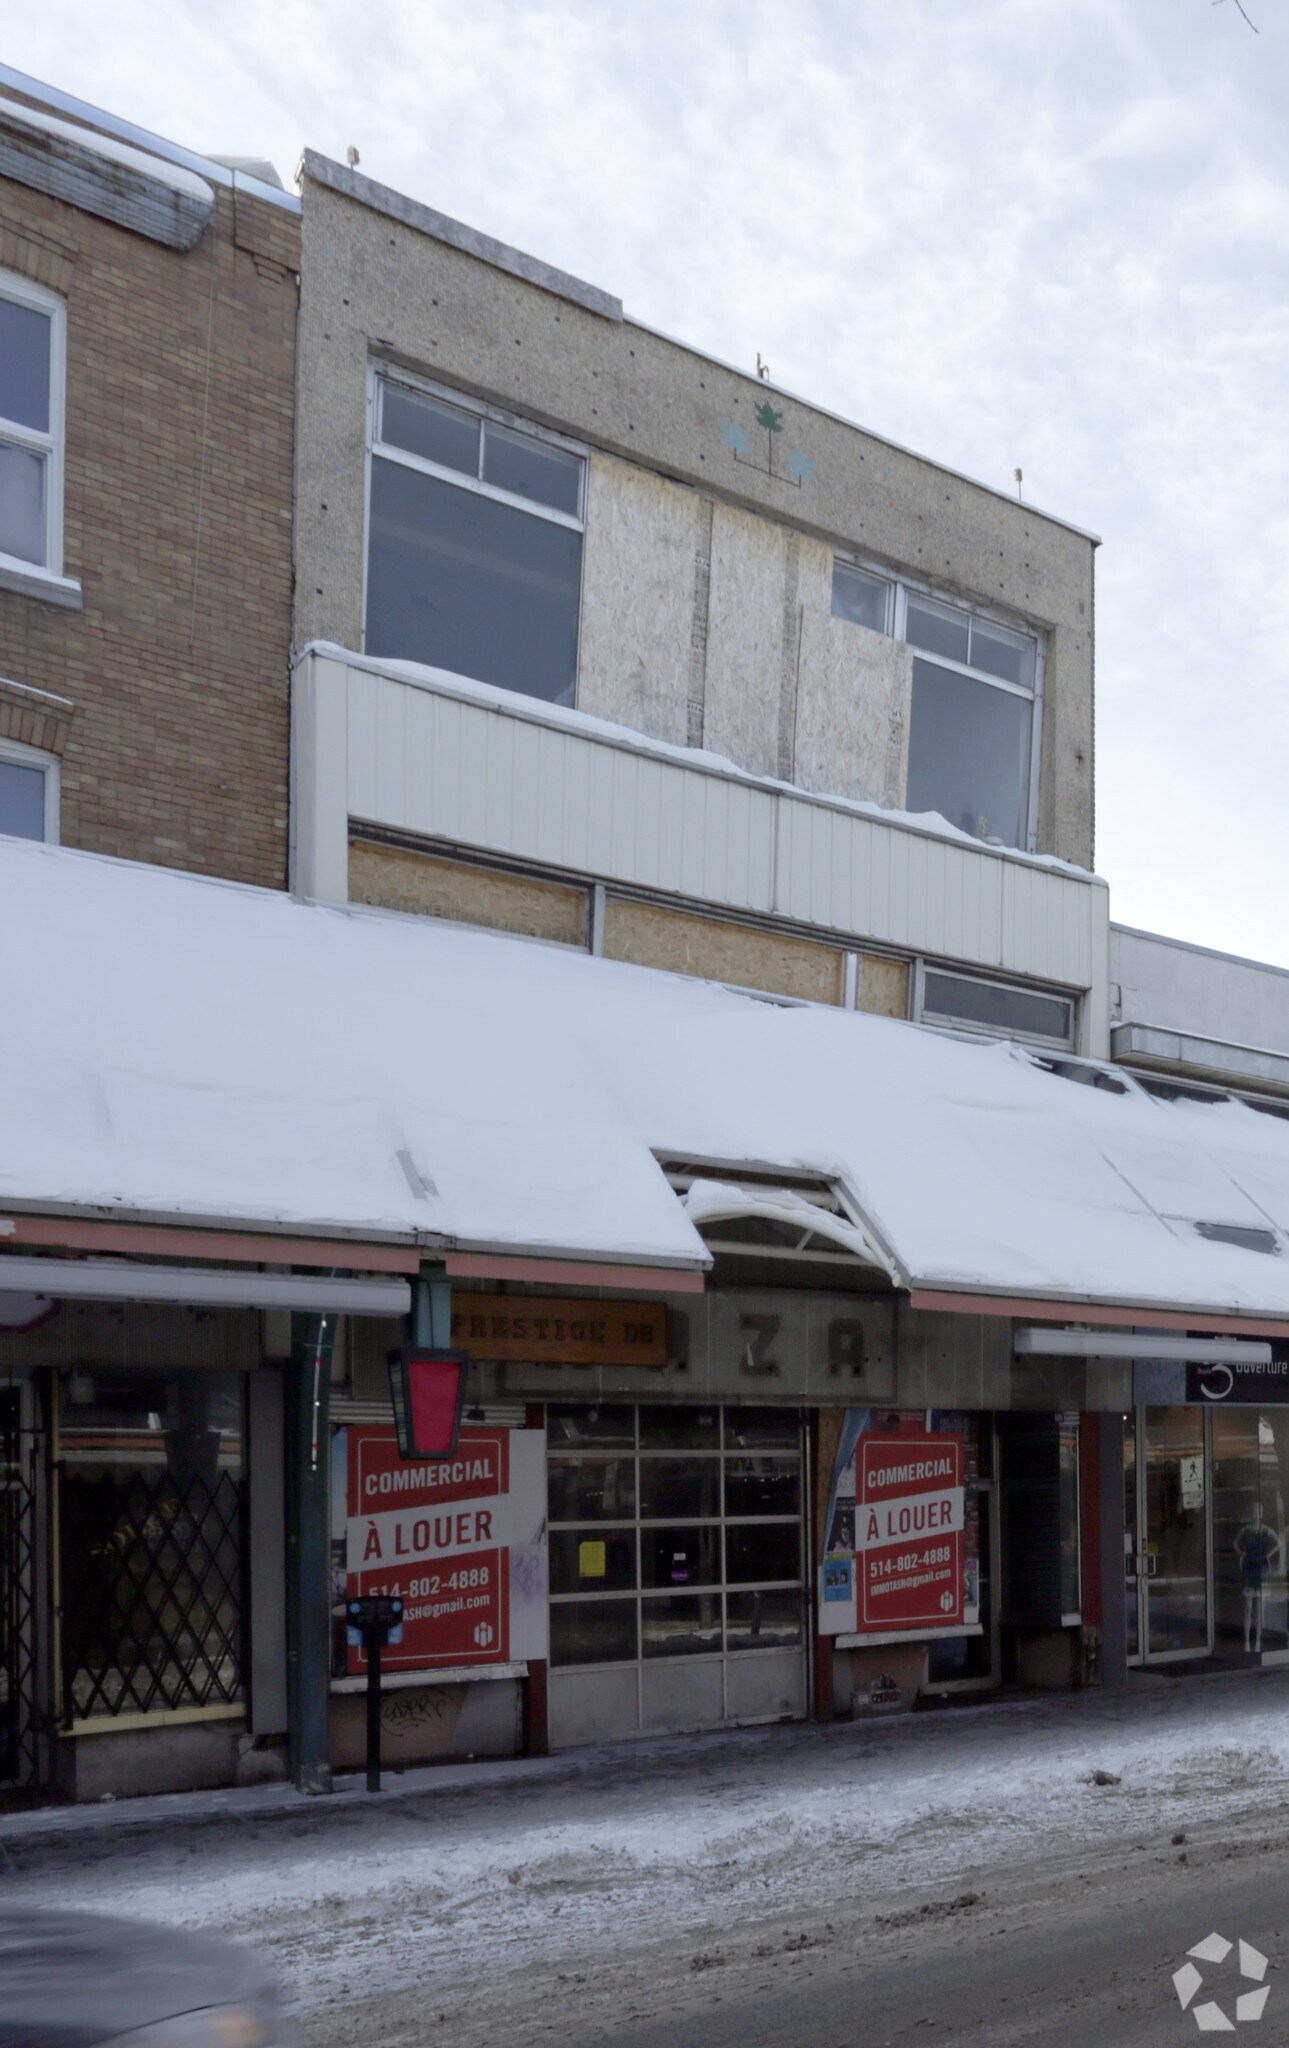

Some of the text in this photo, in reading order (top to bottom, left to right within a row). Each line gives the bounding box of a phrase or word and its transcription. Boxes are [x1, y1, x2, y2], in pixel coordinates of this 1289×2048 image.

[365, 1458, 493, 1496] COMMERCIAL
[867, 1457, 953, 1489] COMMERCIAL
[363, 1510, 493, 1562] À LOUER
[866, 1500, 952, 1541] À LOUER
[870, 1546, 951, 1578] 514-802-4888
[871, 1568, 952, 1596] IMMOTASH@gmail.com
